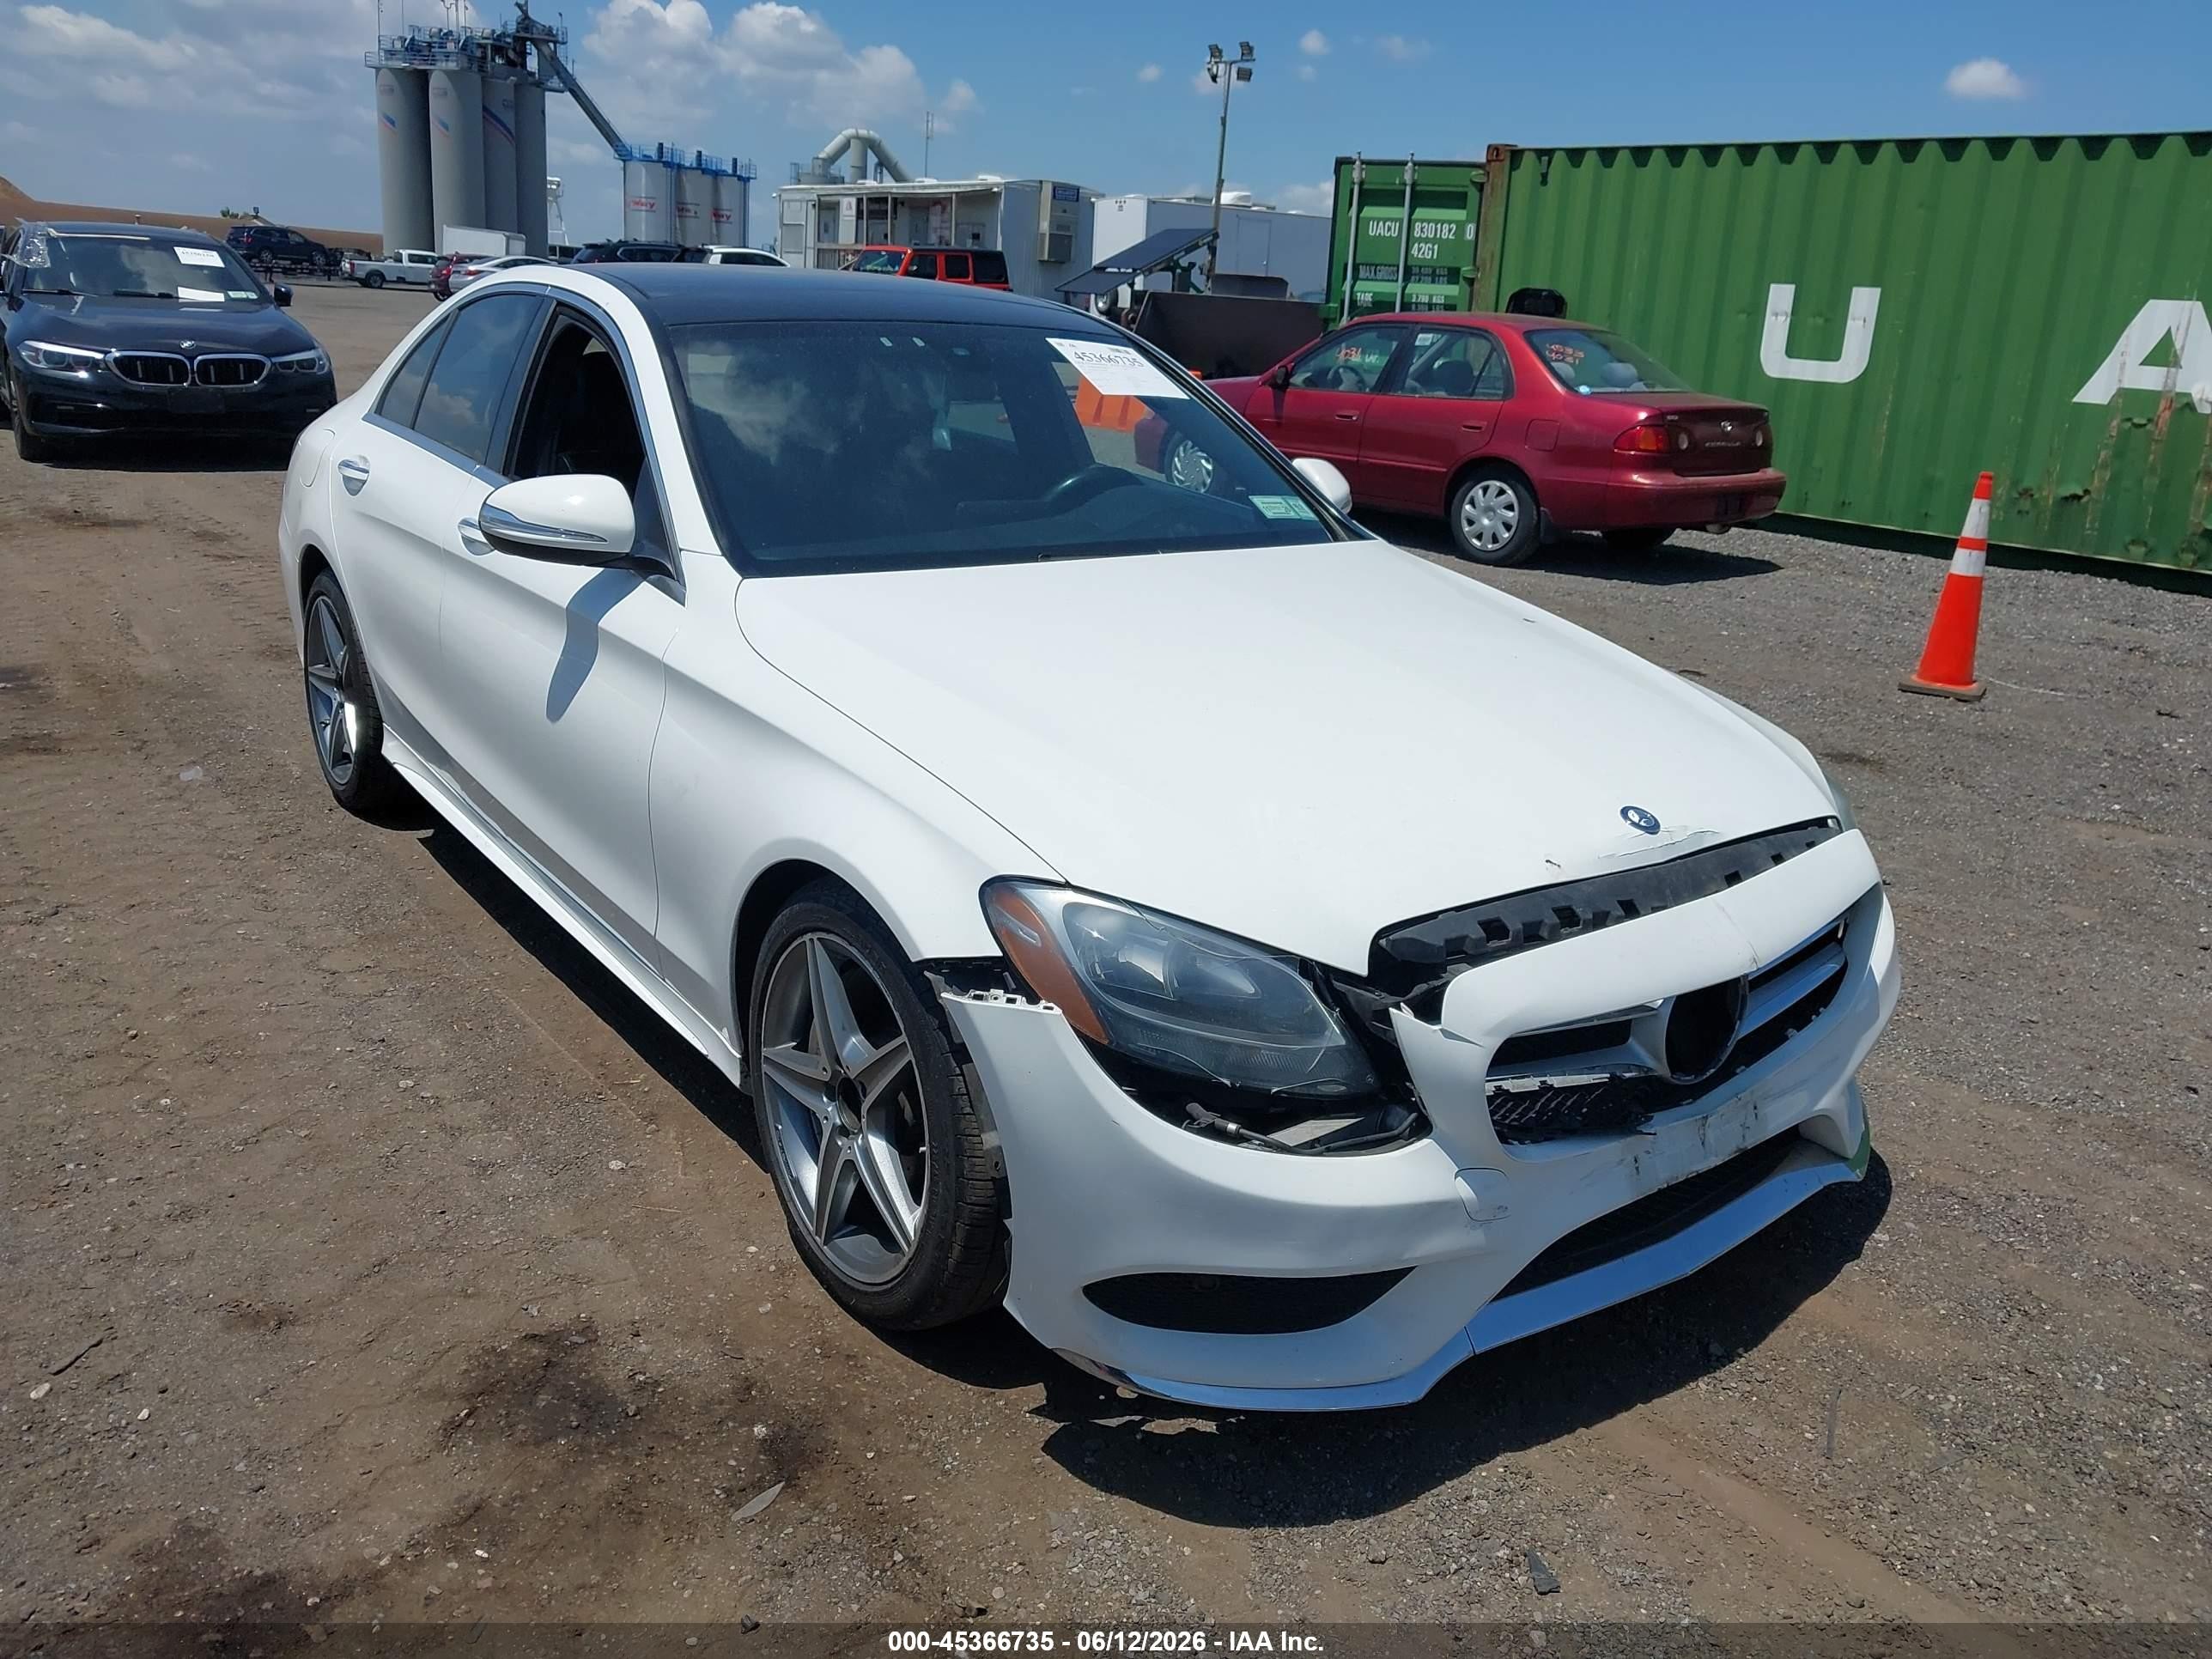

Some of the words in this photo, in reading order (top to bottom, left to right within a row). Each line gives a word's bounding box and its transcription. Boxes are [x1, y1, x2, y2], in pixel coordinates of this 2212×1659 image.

[1369, 221, 1400, 237] UACU
[1413, 222, 1456, 239] 830182
[1467, 224, 1475, 240] 0
[1411, 243, 1438, 259] 42G1
[1760, 284, 1881, 383] U
[2072, 299, 2212, 414] A
[1074, 352, 1145, 368] 45366735
